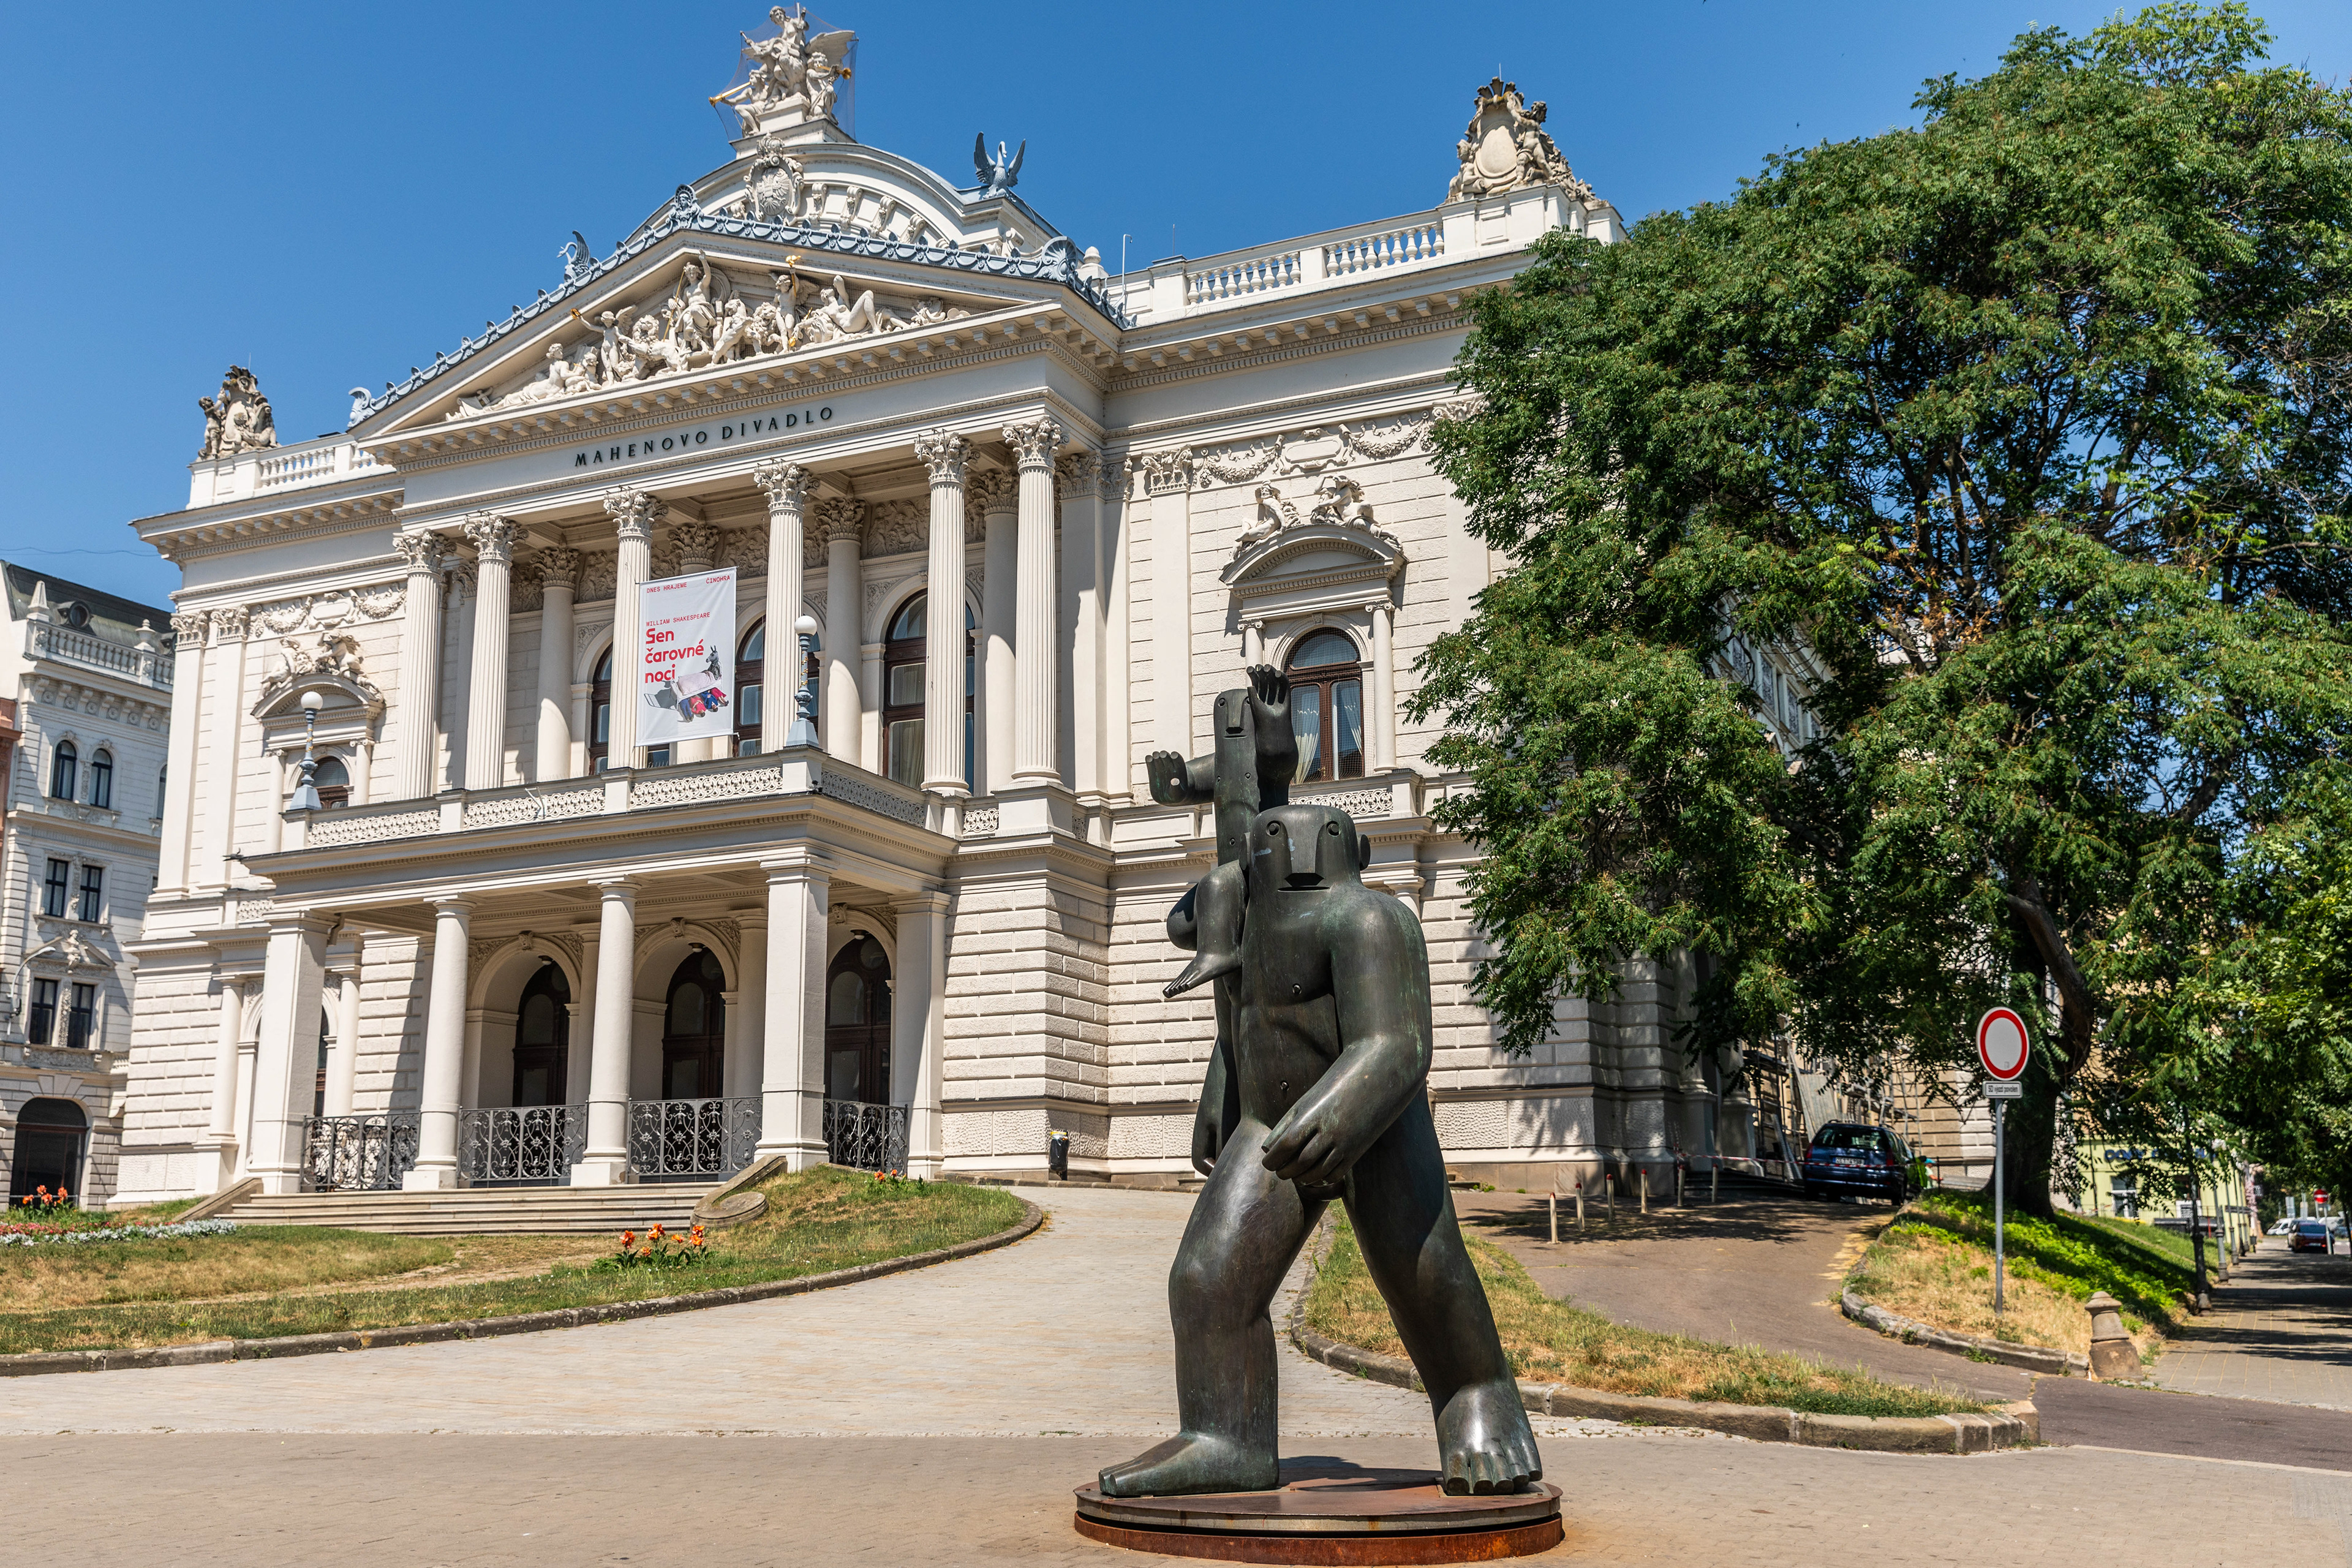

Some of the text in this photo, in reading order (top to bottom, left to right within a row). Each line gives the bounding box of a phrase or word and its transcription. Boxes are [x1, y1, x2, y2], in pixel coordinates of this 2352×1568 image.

[575, 407, 832, 467] MAHENOVO DIVADLO
[663, 582, 687, 591] HRAJEME
[706, 575, 731, 584] ČINOHRA
[646, 612, 710, 627] WILLIAM SHAKESPEARE
[646, 628, 674, 644] Sen
[645, 639, 704, 664] čarovné
[644, 664, 676, 684] noci
